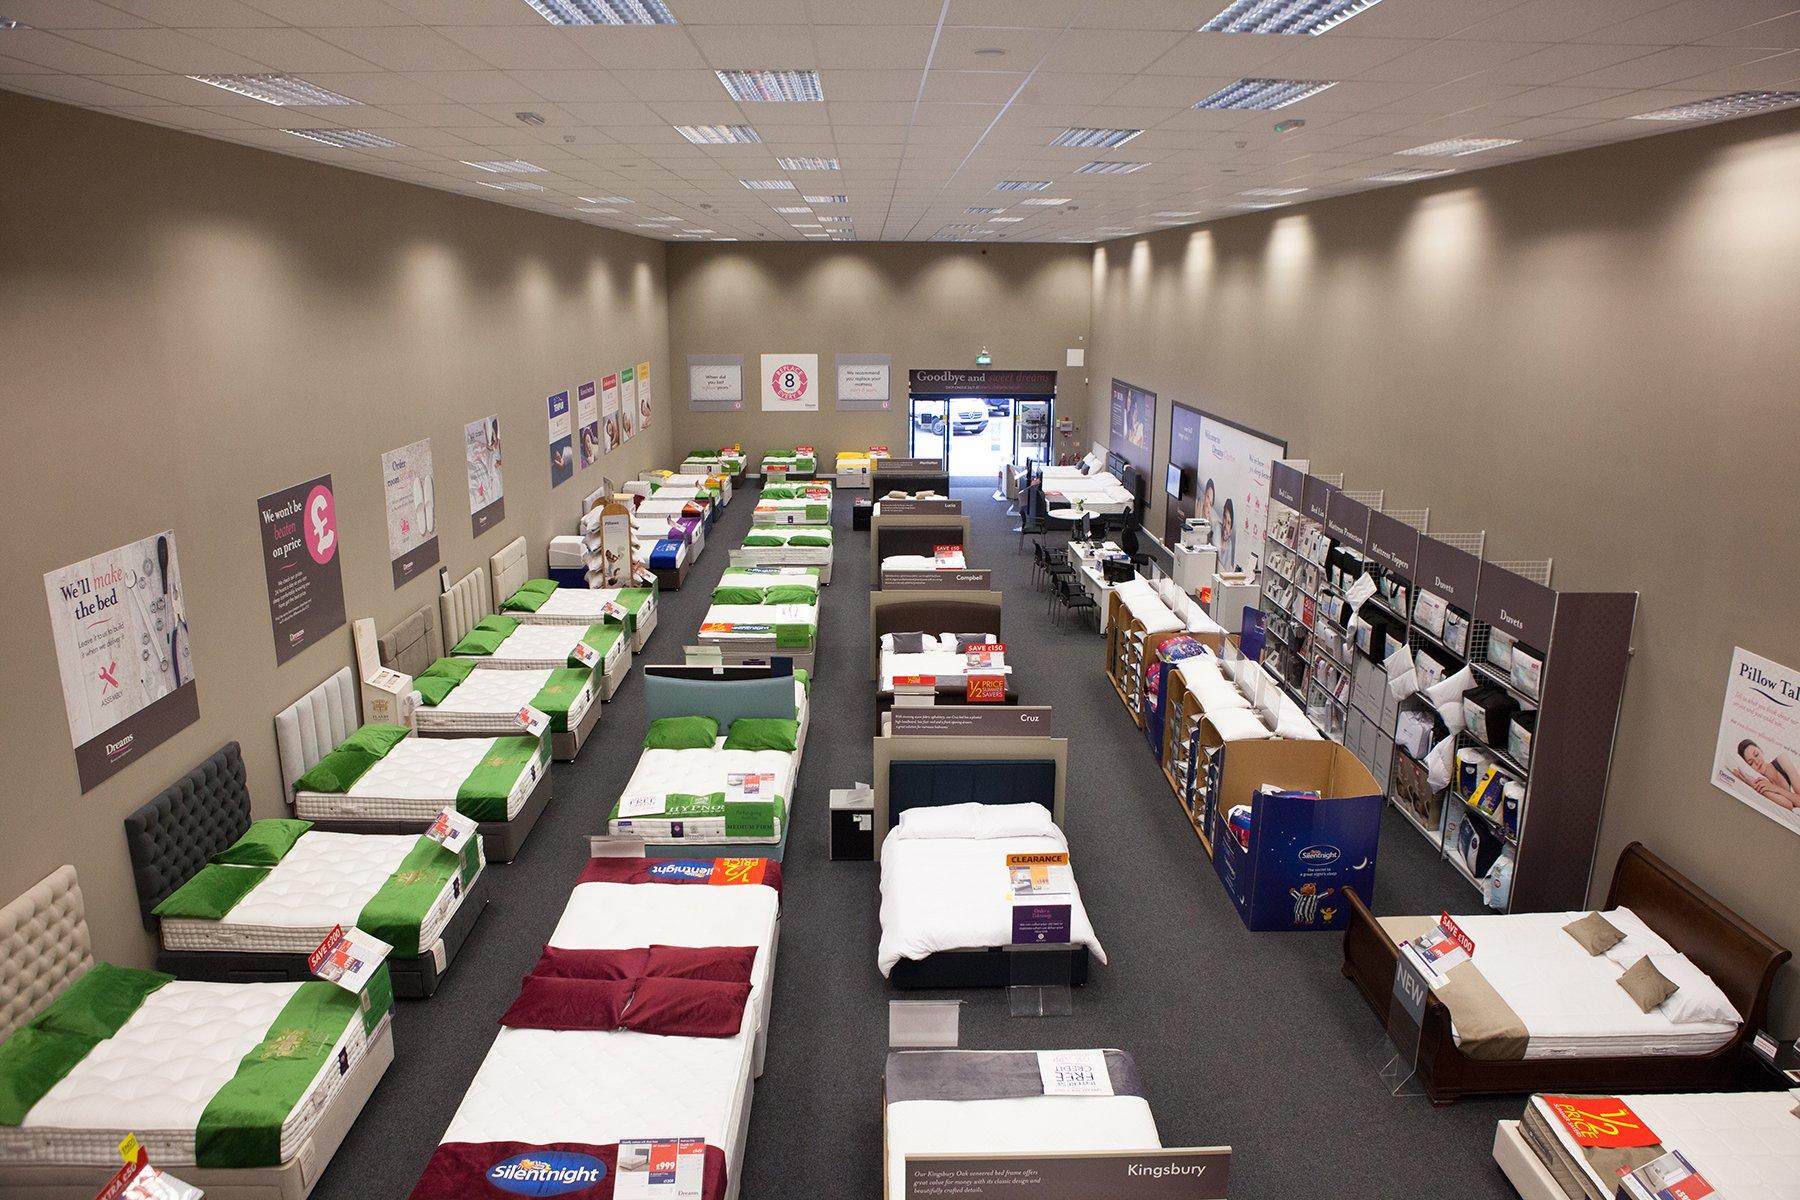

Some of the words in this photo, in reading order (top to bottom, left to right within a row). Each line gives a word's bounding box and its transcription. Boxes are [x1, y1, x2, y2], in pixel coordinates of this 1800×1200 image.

[785, 373, 795, 388] 8
[917, 371, 965, 385] Goodbye
[968, 373, 986, 382] and
[988, 372, 1014, 382] sweet
[1016, 371, 1049, 382] dreams
[262, 509, 275, 524] We
[275, 502, 293, 520] won't
[293, 500, 302, 513] be
[273, 522, 297, 541] beaten
[311, 494, 335, 556] £
[272, 547, 283, 558] on
[283, 537, 302, 558] price
[1372, 542, 1391, 560] Mattress
[1391, 552, 1408, 569] Toppers
[60, 577, 91, 602] We'll
[93, 563, 123, 590] make
[956, 574, 983, 582] Campbell
[1435, 576, 1454, 594] Duvets
[75, 601, 96, 620] the
[95, 588, 118, 612] bed
[1500, 609, 1524, 630] Duvets
[78, 637, 93, 649] Leave
[1739, 662, 1777, 690] Pillow
[1780, 679, 1800, 701] Tal
[1020, 714, 1039, 722] Cruz
[105, 734, 134, 755] Dreams
[1011, 855, 1062, 863] CLEARANCE
[1302, 852, 1338, 860] Silentnight
[1442, 916, 1457, 937] SAVE
[1458, 934, 1472, 952] £100
[311, 944, 328, 967] SAVE
[327, 929, 341, 948] £200
[1397, 961, 1424, 1006] NEW
[1055, 1072, 1094, 1081] FREE
[1560, 1103, 1598, 1140] PRICE
[123, 1163, 137, 1181] £50
[492, 1165, 599, 1184] Silentnight
[656, 1162, 675, 1170] £999
[927, 1170, 955, 1178] Kingsbury
[1022, 1169, 1038, 1177] offers
[1128, 1163, 1206, 1178] Kingsbury
[913, 1187, 943, 1195] beautifully
[944, 1187, 963, 1195] crafted
